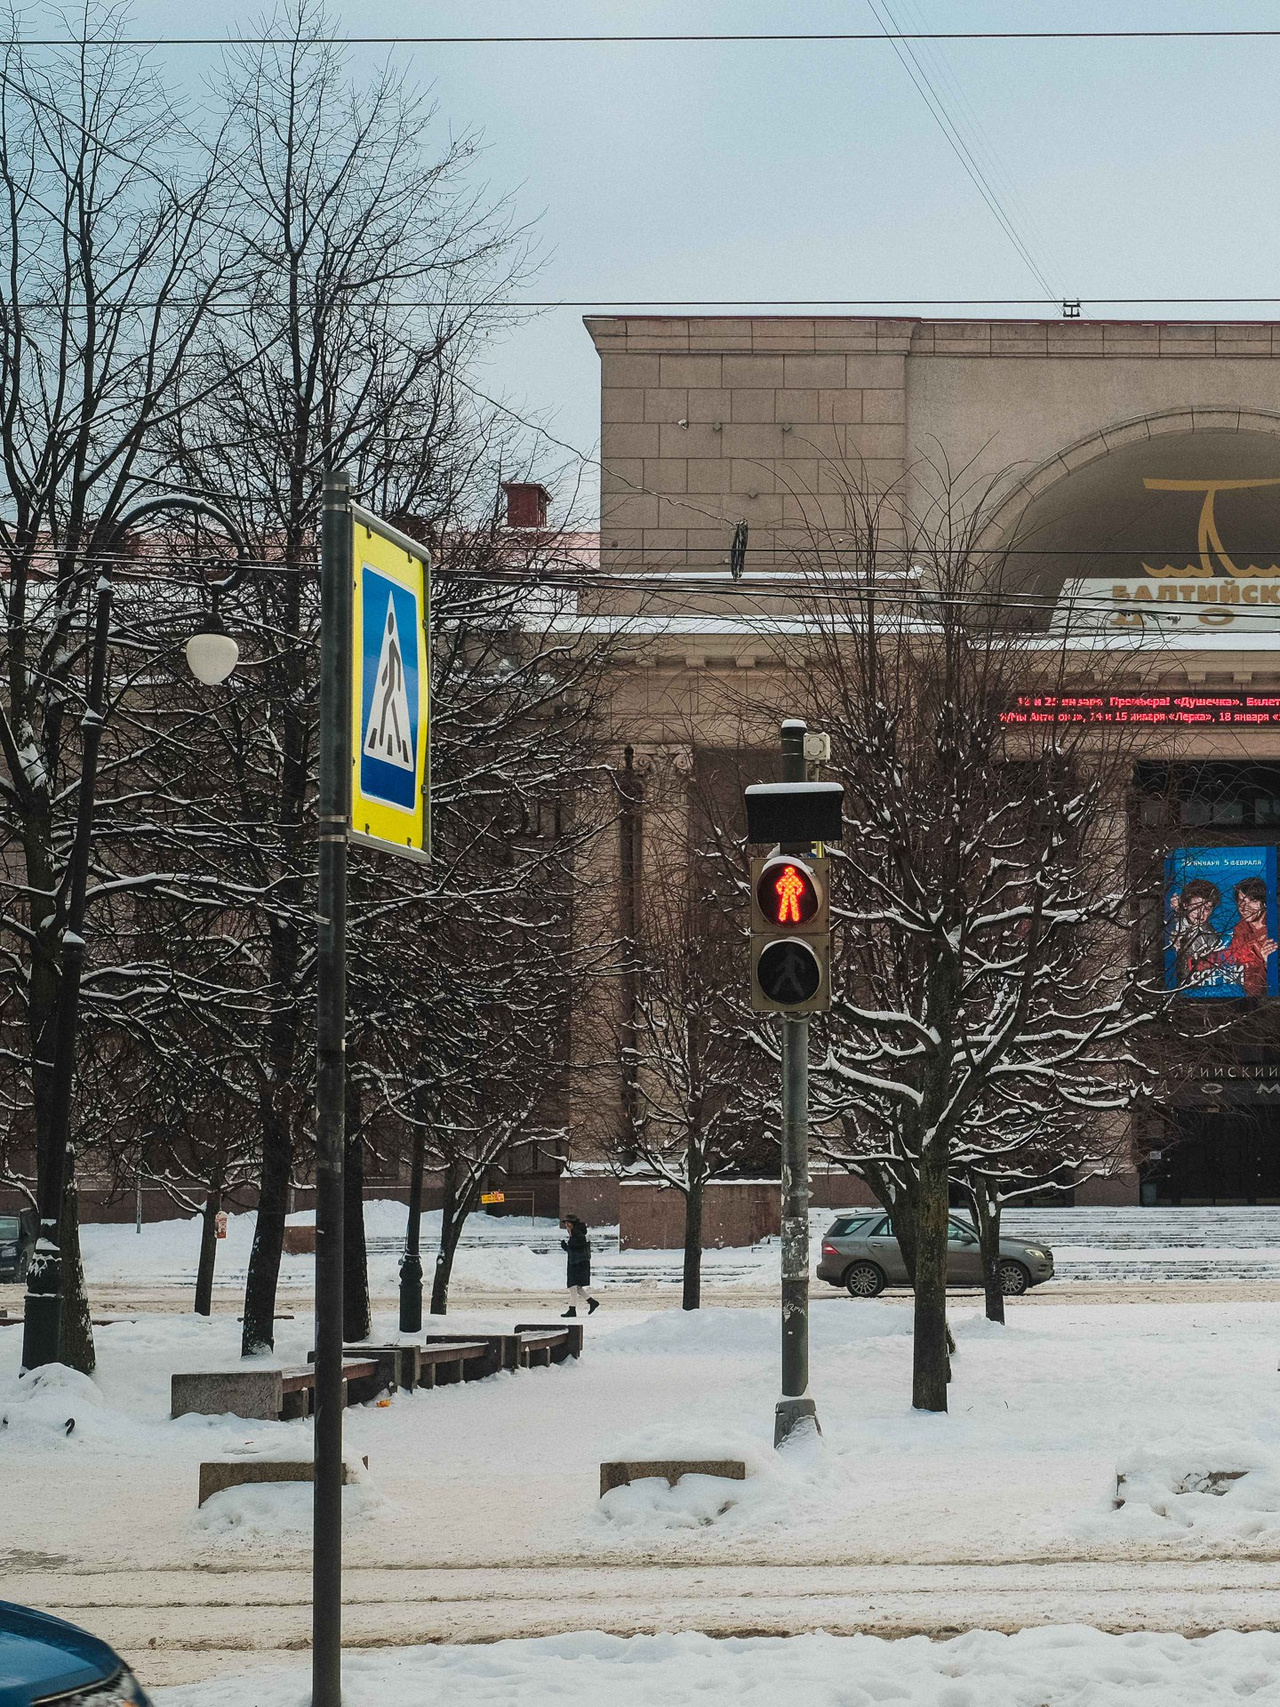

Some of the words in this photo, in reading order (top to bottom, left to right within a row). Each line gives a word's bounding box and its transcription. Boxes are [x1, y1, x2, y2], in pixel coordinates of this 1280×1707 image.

[1109, 696, 1170, 709] Премьера!
[1173, 696, 1243, 708] «Душечка».
[1105, 713, 1112, 721] и
[1115, 711, 1128, 721] 15
[1130, 713, 1166, 724] января
[1219, 712, 1232, 721] 18
[1234, 713, 1270, 724] января
[1224, 859, 1229, 867] 5
